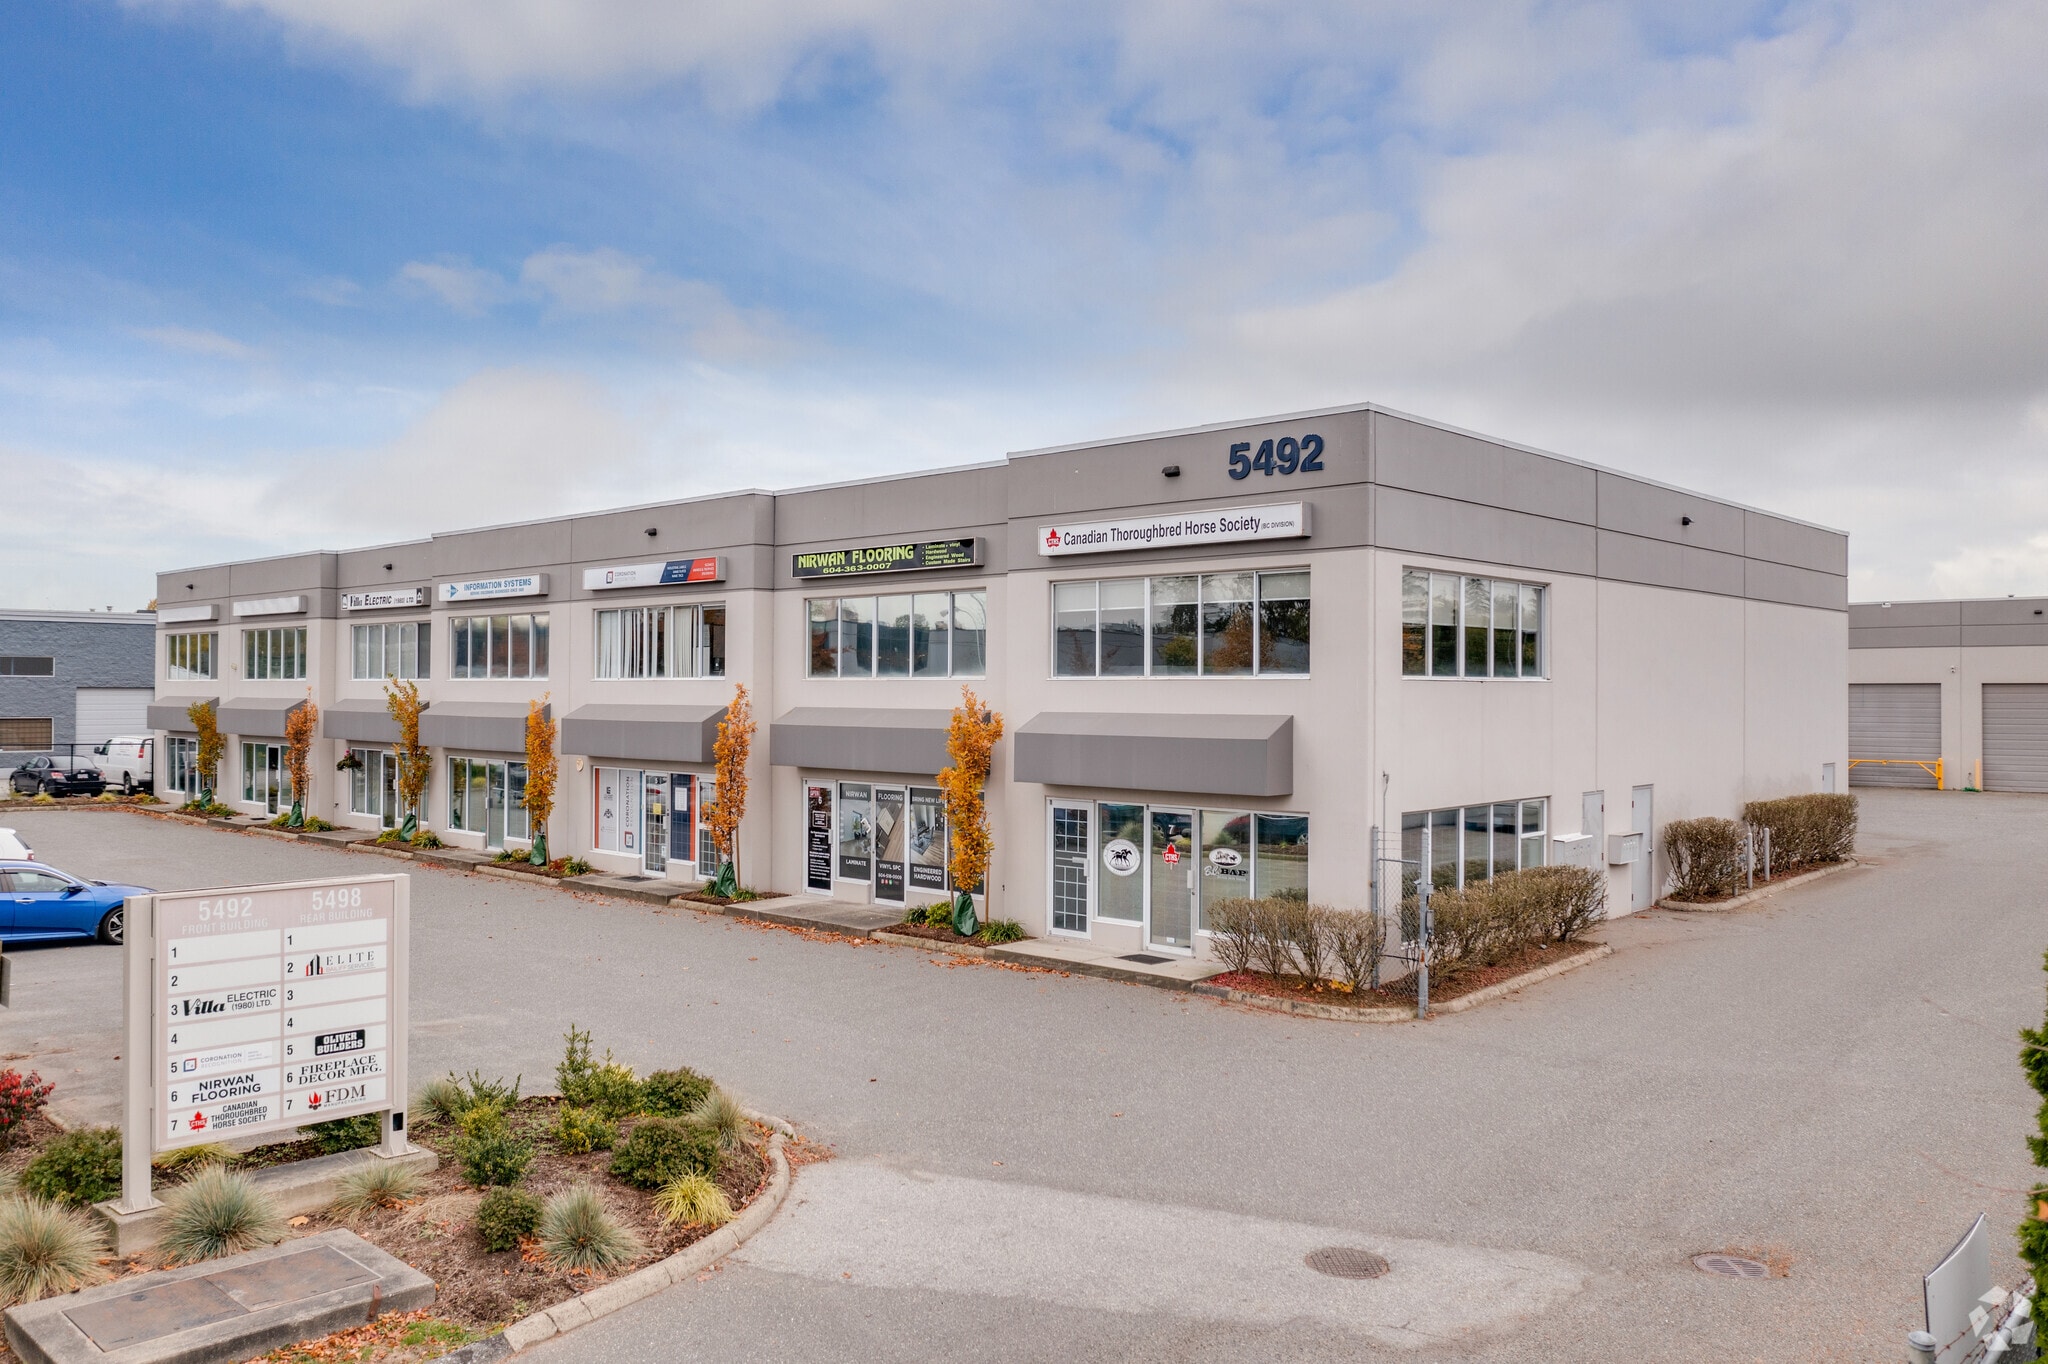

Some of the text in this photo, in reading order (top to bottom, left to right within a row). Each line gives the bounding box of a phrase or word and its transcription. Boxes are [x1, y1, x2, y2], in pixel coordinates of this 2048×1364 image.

[1228, 434, 1325, 480] 5492
[1064, 530, 1108, 546] Canadian
[1110, 521, 1182, 542] Thoroughbred
[1185, 520, 1217, 535] Horse
[1219, 516, 1261, 534] Society
[1270, 521, 1295, 529] DIVISION)
[798, 545, 914, 569] NIRWAN FLOORING
[822, 562, 892, 574] 604-363-0007
[463, 578, 532, 591] INFORMATION SYSTEMS
[845, 790, 868, 799] NIRWAN
[878, 793, 904, 801] FLOORING
[1168, 824, 1176, 835] 7
[845, 859, 867, 867] LAMINATE
[913, 866, 943, 876] ENGINEERED
[913, 874, 942, 882] HARDWOOD
[312, 887, 362, 911] 5498
[198, 896, 253, 921] 5492
[300, 908, 373, 923] REAR BUILDING
[182, 918, 269, 935] FRONT BUILDING
[287, 934, 292, 945] 1
[171, 946, 177, 958] 1
[287, 951, 375, 973] 2 ELITE
[171, 975, 178, 987] 2
[171, 988, 277, 1016] 3 Villa ELECTRIC
[287, 989, 294, 1001] 3
[231, 999, 273, 1011] (1980) LTD.
[287, 1017, 293, 1028] 4
[171, 1033, 178, 1044] 4
[287, 1031, 358, 1055] 5 OLIVER
[316, 1039, 364, 1055] BUILDERS
[171, 1061, 178, 1073] 5
[200, 1052, 243, 1063] CORONATION
[200, 1058, 242, 1068] RECOGNITION
[287, 1054, 377, 1083] 6 FIREPLACE
[298, 1063, 382, 1085] DECOR MFG.
[171, 1073, 254, 1102] 6 NIRWAN
[191, 1083, 262, 1103] FLOORING
[286, 1084, 366, 1110] 7 FDM
[171, 1100, 258, 1131] 7 CANADIAN
[211, 1105, 268, 1122] THOROUGHBRED
[212, 1113, 267, 1130] HORSE SOCIETY
